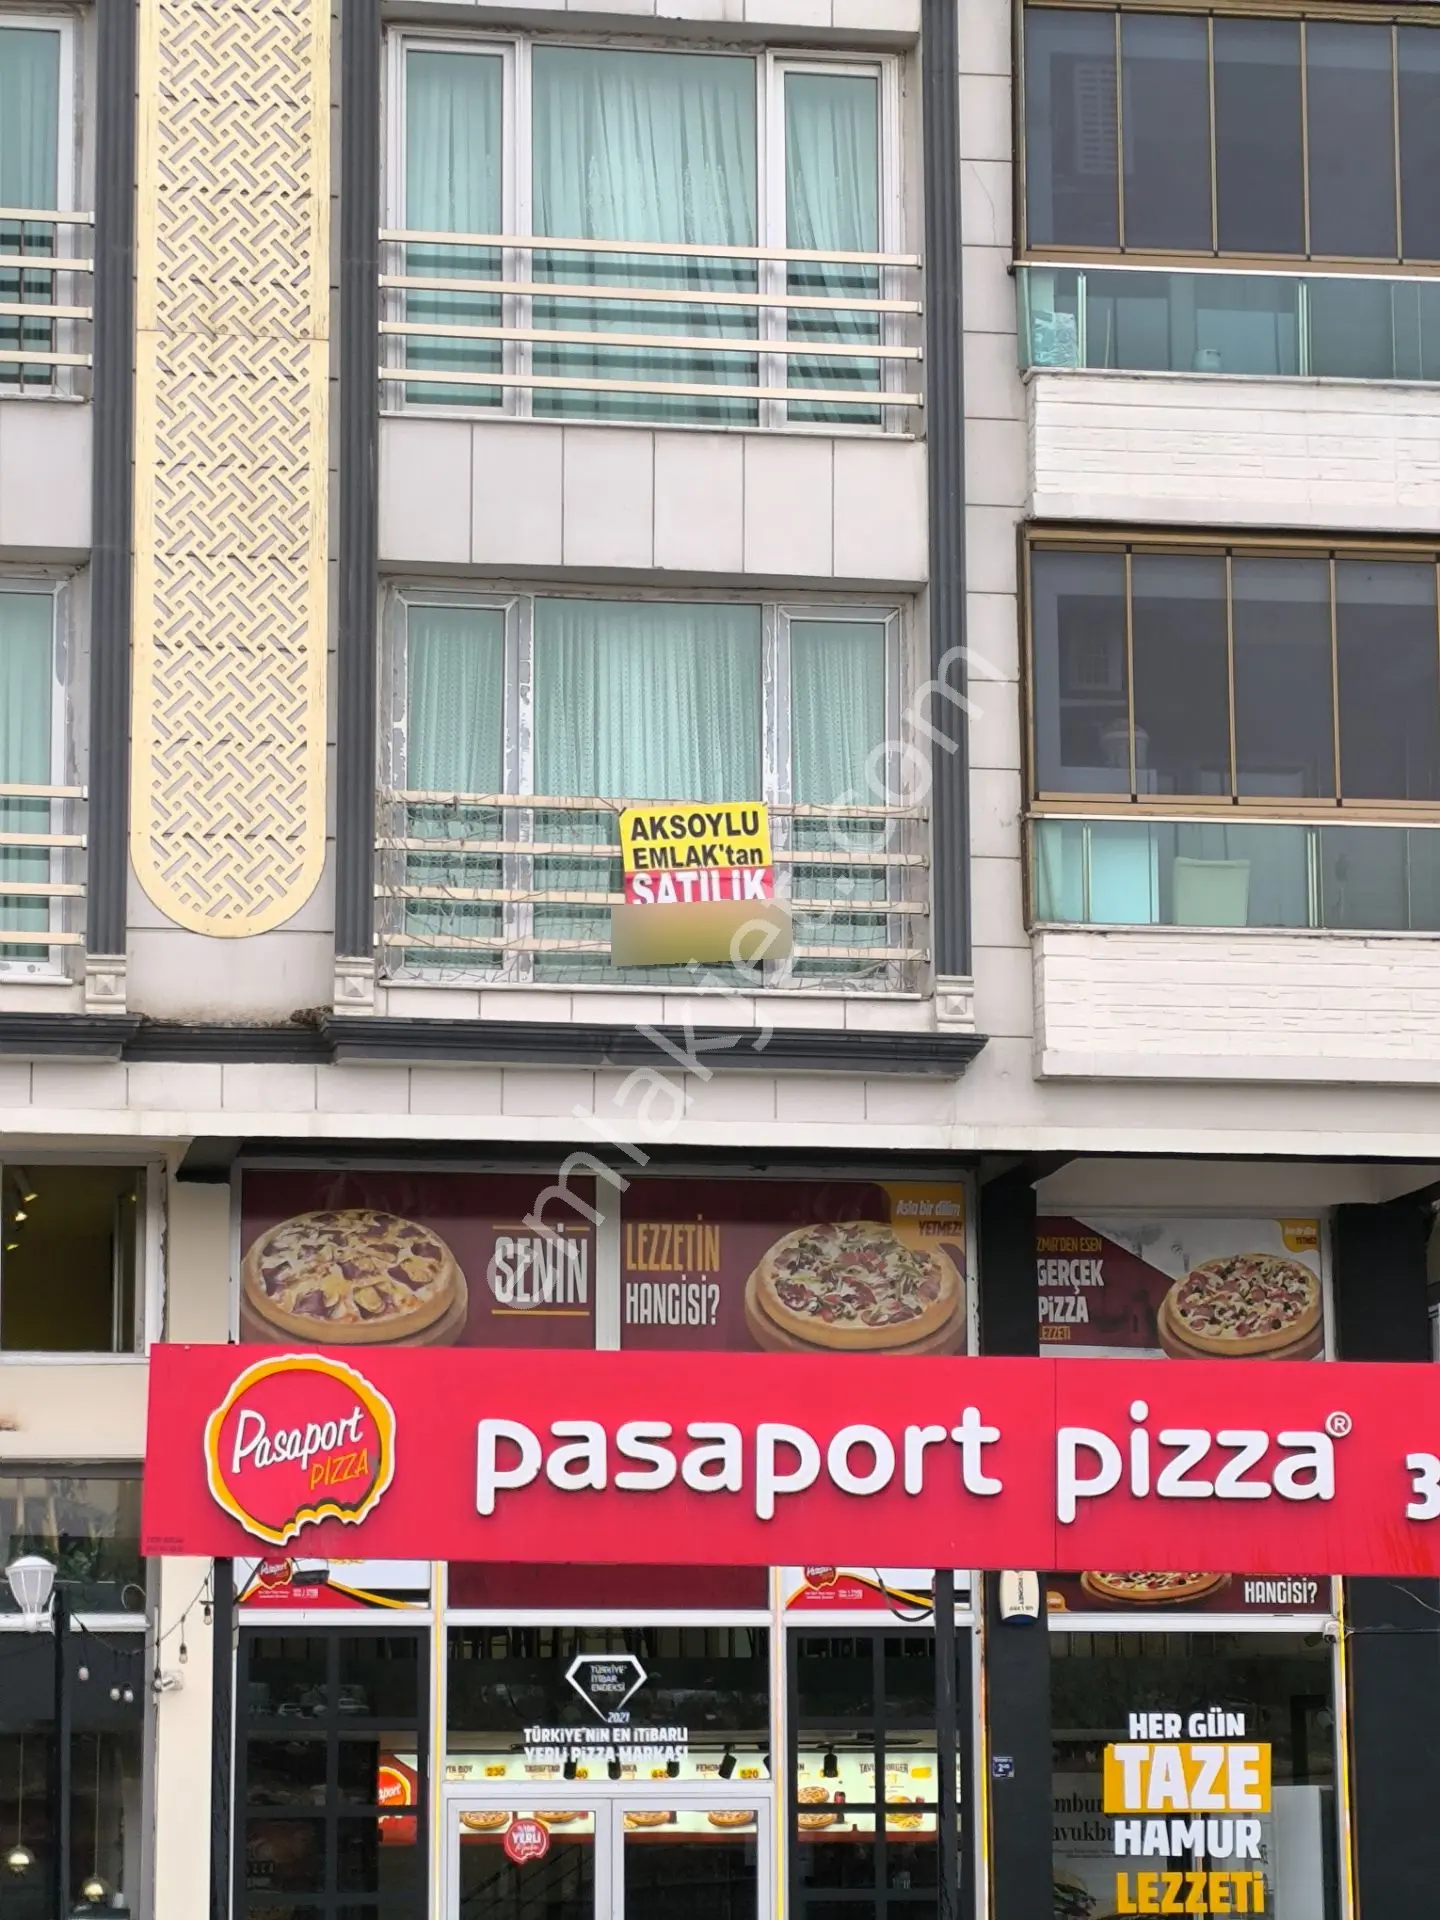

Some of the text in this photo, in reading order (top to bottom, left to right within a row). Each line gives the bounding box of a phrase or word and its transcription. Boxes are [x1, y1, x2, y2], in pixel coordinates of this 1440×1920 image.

[631, 811, 760, 842] AKSOYLU
[633, 844, 763, 870] EMLAK'tan
[626, 1214, 720, 1272] LEZZETİN
[495, 1223, 588, 1303] SENİN
[1037, 1259, 1105, 1294] GERÇEK
[625, 1275, 720, 1325] HANGİSİ?
[1038, 1296, 1090, 1323] PİZZA
[232, 1406, 364, 1474] Pasaport
[476, 1406, 1003, 1521] pasaport
[1244, 1578, 1318, 1604] HANGİSİ?
[523, 1725, 688, 1743] TÜRKİYE'NİN EN İTİBARLI
[1129, 1707, 1246, 1740] HER GÜN
[570, 1746, 616, 1762] PİZZA
[1114, 1745, 1262, 1810] TAZE
[1114, 1820, 1262, 1859] HAMUR
[1115, 1872, 1265, 1914] LEZZETİ
